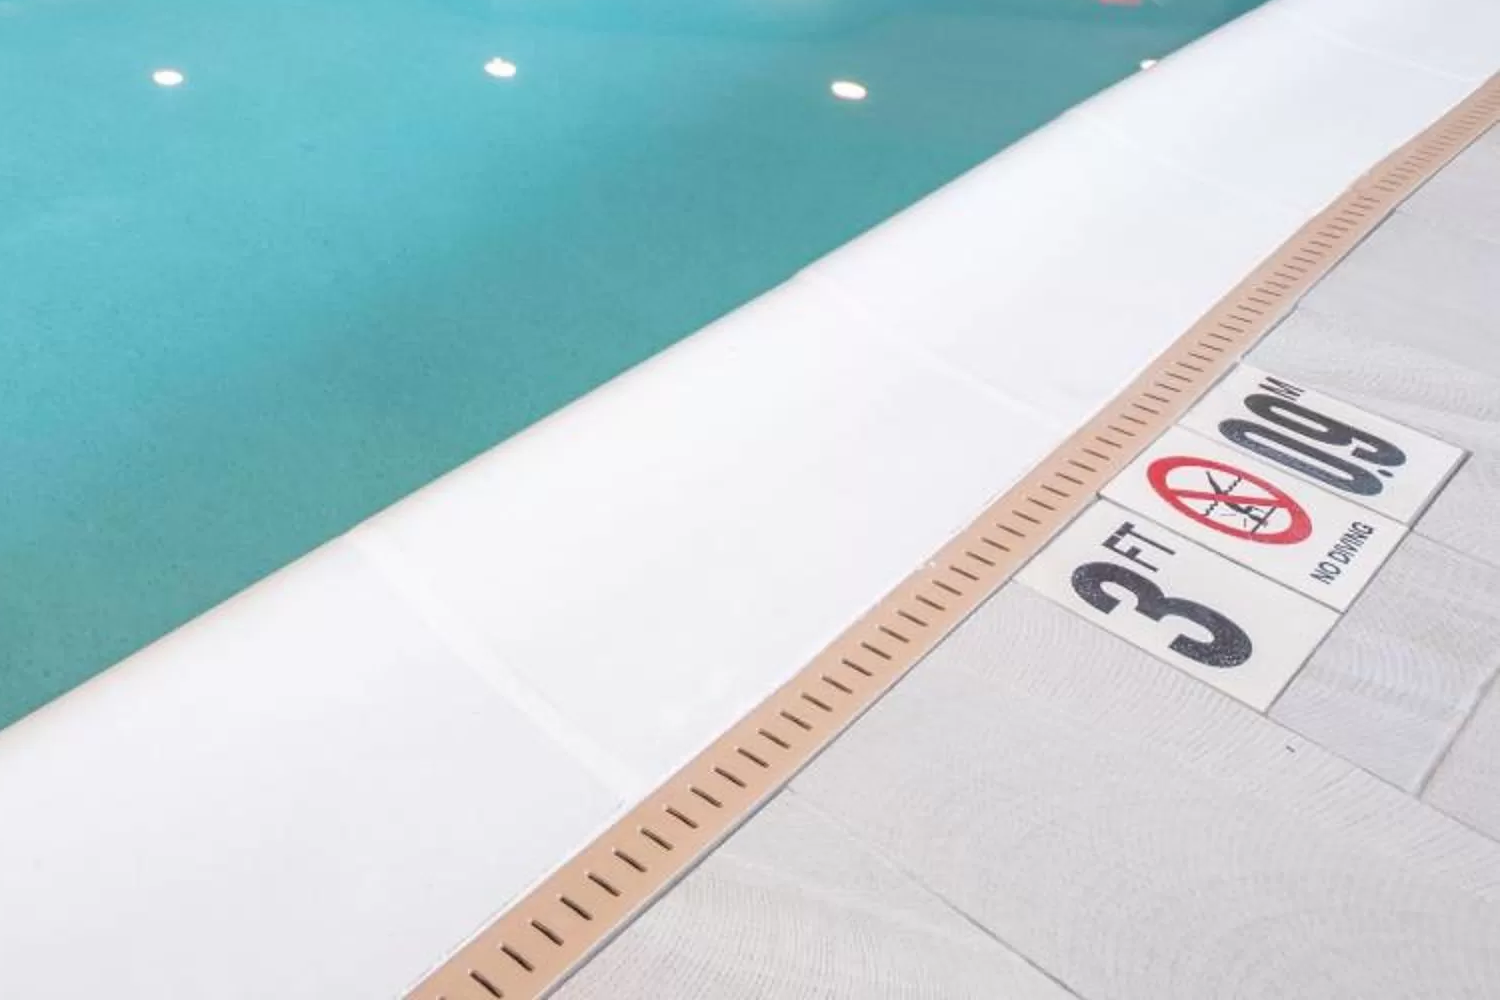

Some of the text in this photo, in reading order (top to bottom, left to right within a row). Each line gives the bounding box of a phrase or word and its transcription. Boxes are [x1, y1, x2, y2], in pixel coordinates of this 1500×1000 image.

[1071, 521, 1253, 668] 3 FT
[1309, 521, 1374, 585] NO DIVING
